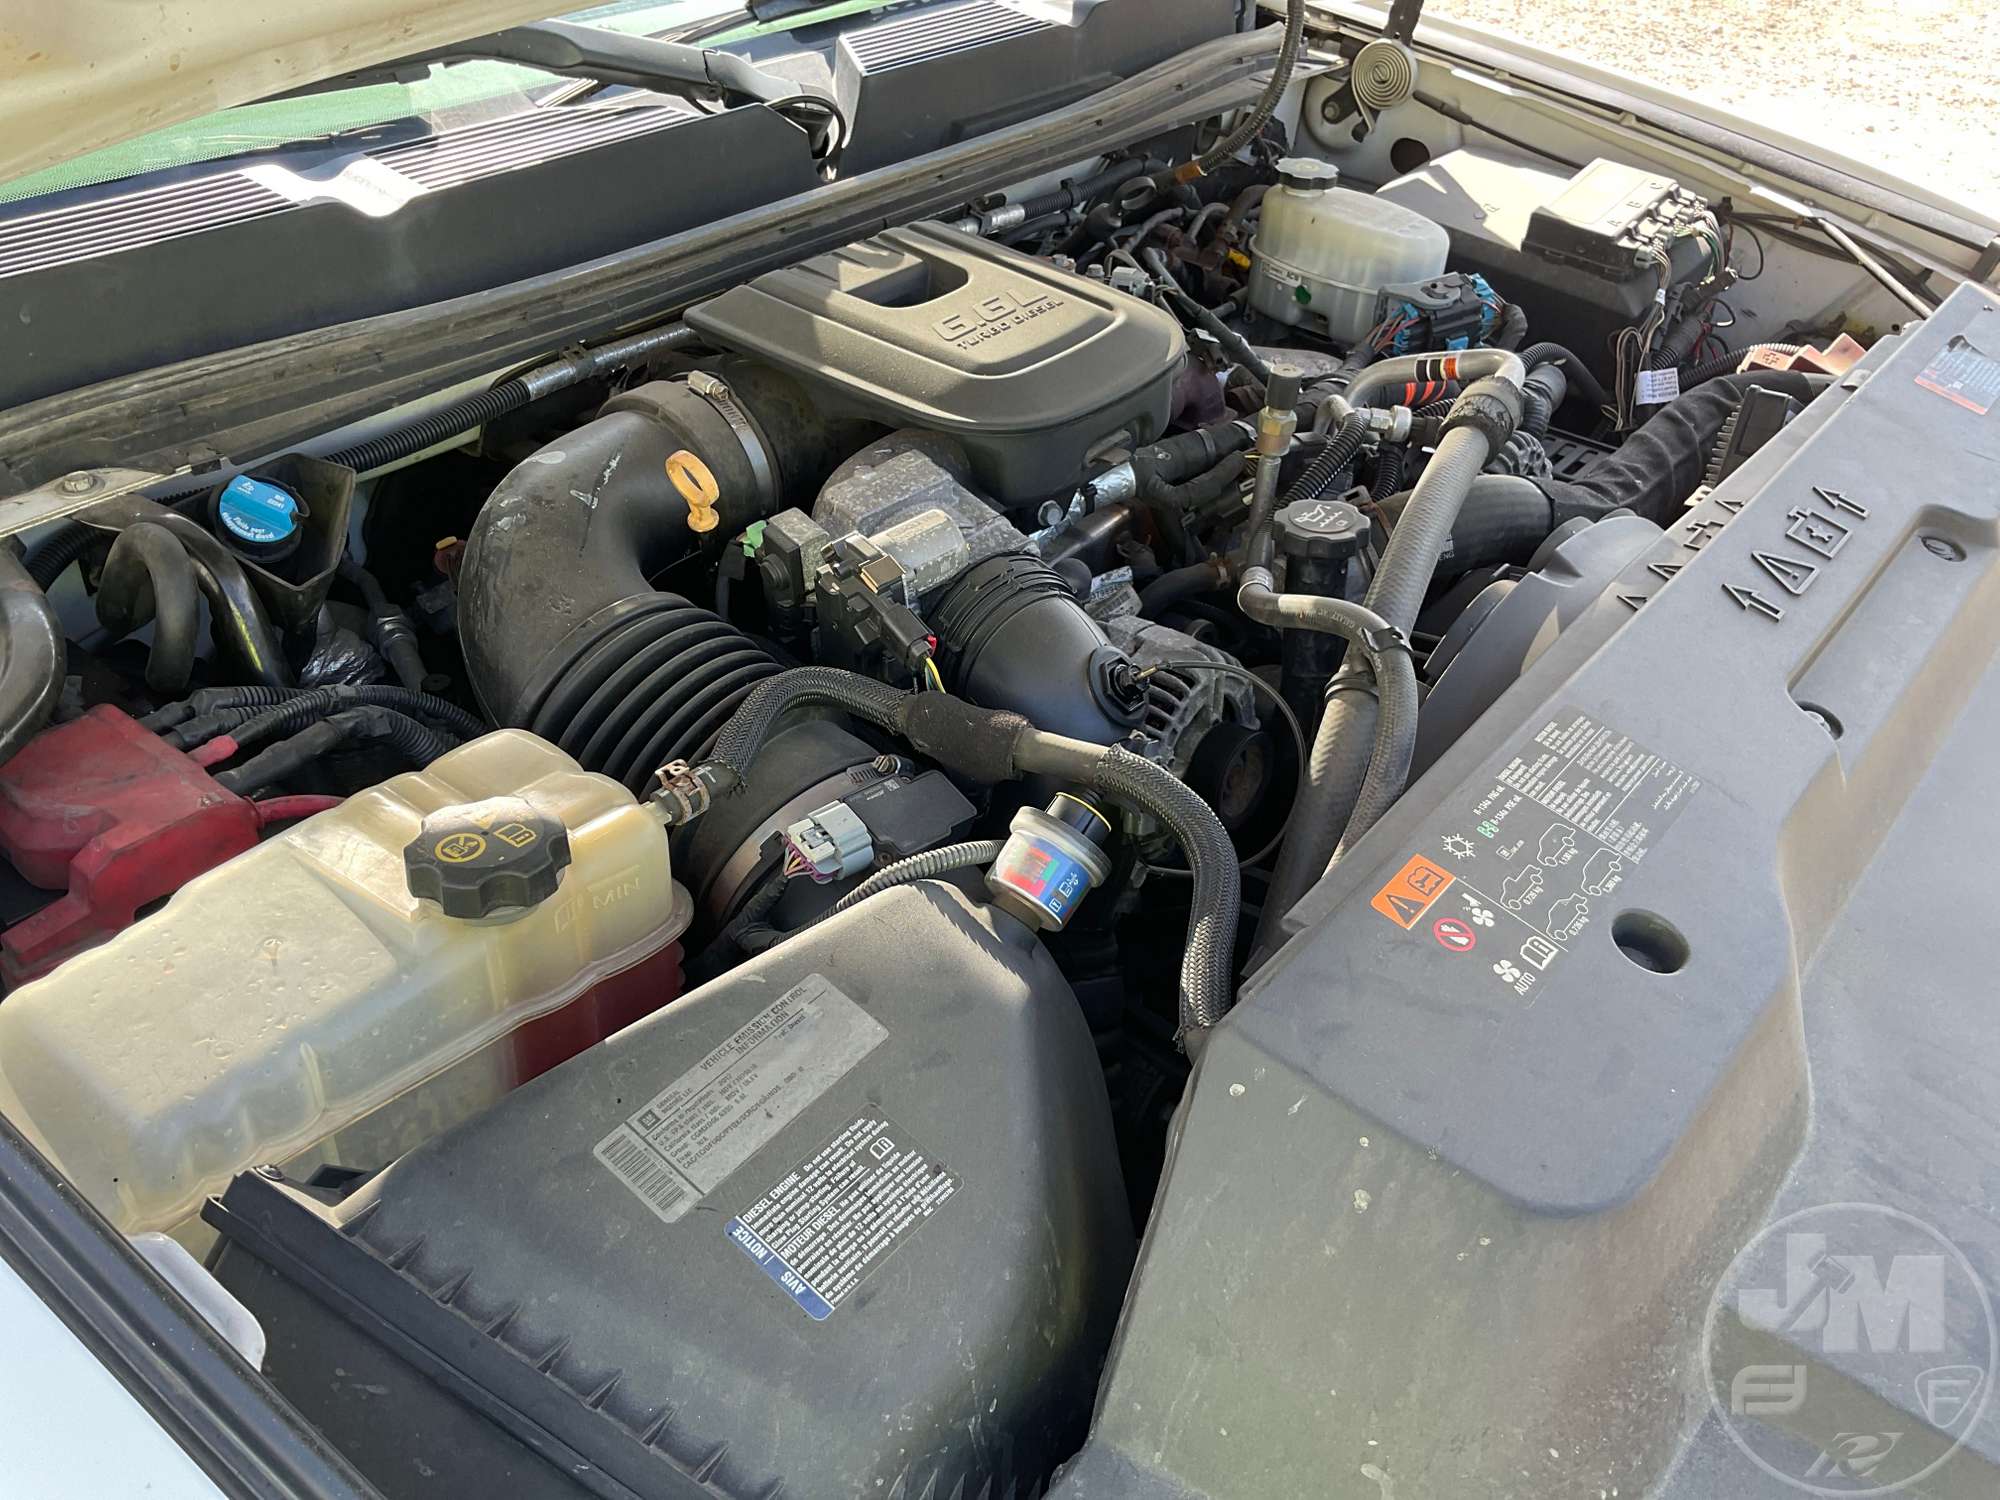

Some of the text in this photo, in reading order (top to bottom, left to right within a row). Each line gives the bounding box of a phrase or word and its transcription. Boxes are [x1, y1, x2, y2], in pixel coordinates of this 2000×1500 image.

[931, 289, 1048, 342] 6.6L
[956, 300, 1064, 350] TURBO DIESEL
[592, 877, 642, 910] MIN
[1513, 972, 1536, 996] AUTO
[700, 985, 807, 1071] VEHICLE EMISSION CONTROL
[734, 1010, 789, 1054] INFORMATION
[741, 1195, 773, 1223] DIESEL
[768, 1171, 801, 1199] ENGINE
[802, 1162, 813, 1171] Do
[810, 1154, 822, 1165] not
[820, 1146, 832, 1157] use
[829, 1129, 851, 1148] starting
[750, 1118, 877, 1229] Immediate engine damage can result. Do not apply
[757, 1120, 889, 1236] more than nominal 12 volts to electrical system during
[763, 1219, 791, 1243] charging
[787, 1213, 797, 1222] or
[829, 1165, 850, 1184] Failure
[847, 1159, 857, 1167] of
[770, 1163, 866, 1249] Glow Plug Starting System can result.
[779, 1150, 902, 1259] MOTEUR DIESEL Ne pas utiliser de liquide
[788, 1256, 799, 1266] de
[826, 1219, 840, 1231] Des
[836, 1194, 868, 1222] dommages
[896, 1149, 917, 1167] moteur
[732, 1226, 768, 1260] NOTICE
[795, 1244, 827, 1273] pourraient
[823, 1238, 833, 1247] en
[860, 1202, 873, 1214] pas
[868, 1179, 897, 1205] appliquer
[893, 1171, 906, 1182] une
[902, 1154, 924, 1174] tension
[802, 1253, 830, 1279] nominale
[827, 1246, 838, 1256] de
[834, 1235, 850, 1250] plus
[846, 1228, 857, 1238] de
[854, 1222, 864, 1231] 12
[861, 1210, 877, 1224] volts
[824, 1289, 834, 1299] du
[853, 1261, 863, 1271] de
[892, 1212, 916, 1234] bougies
[912, 1206, 922, 1215] de
[780, 1270, 806, 1295] AVIS
[809, 1263, 835, 1286] pendant
[831, 1257, 840, 1265] la
[837, 1240, 859, 1260] charge
[862, 1228, 871, 1236] le
[816, 1271, 839, 1292] batterie
[865, 1225, 889, 1247] pourrait
[885, 1220, 894, 1228] en
